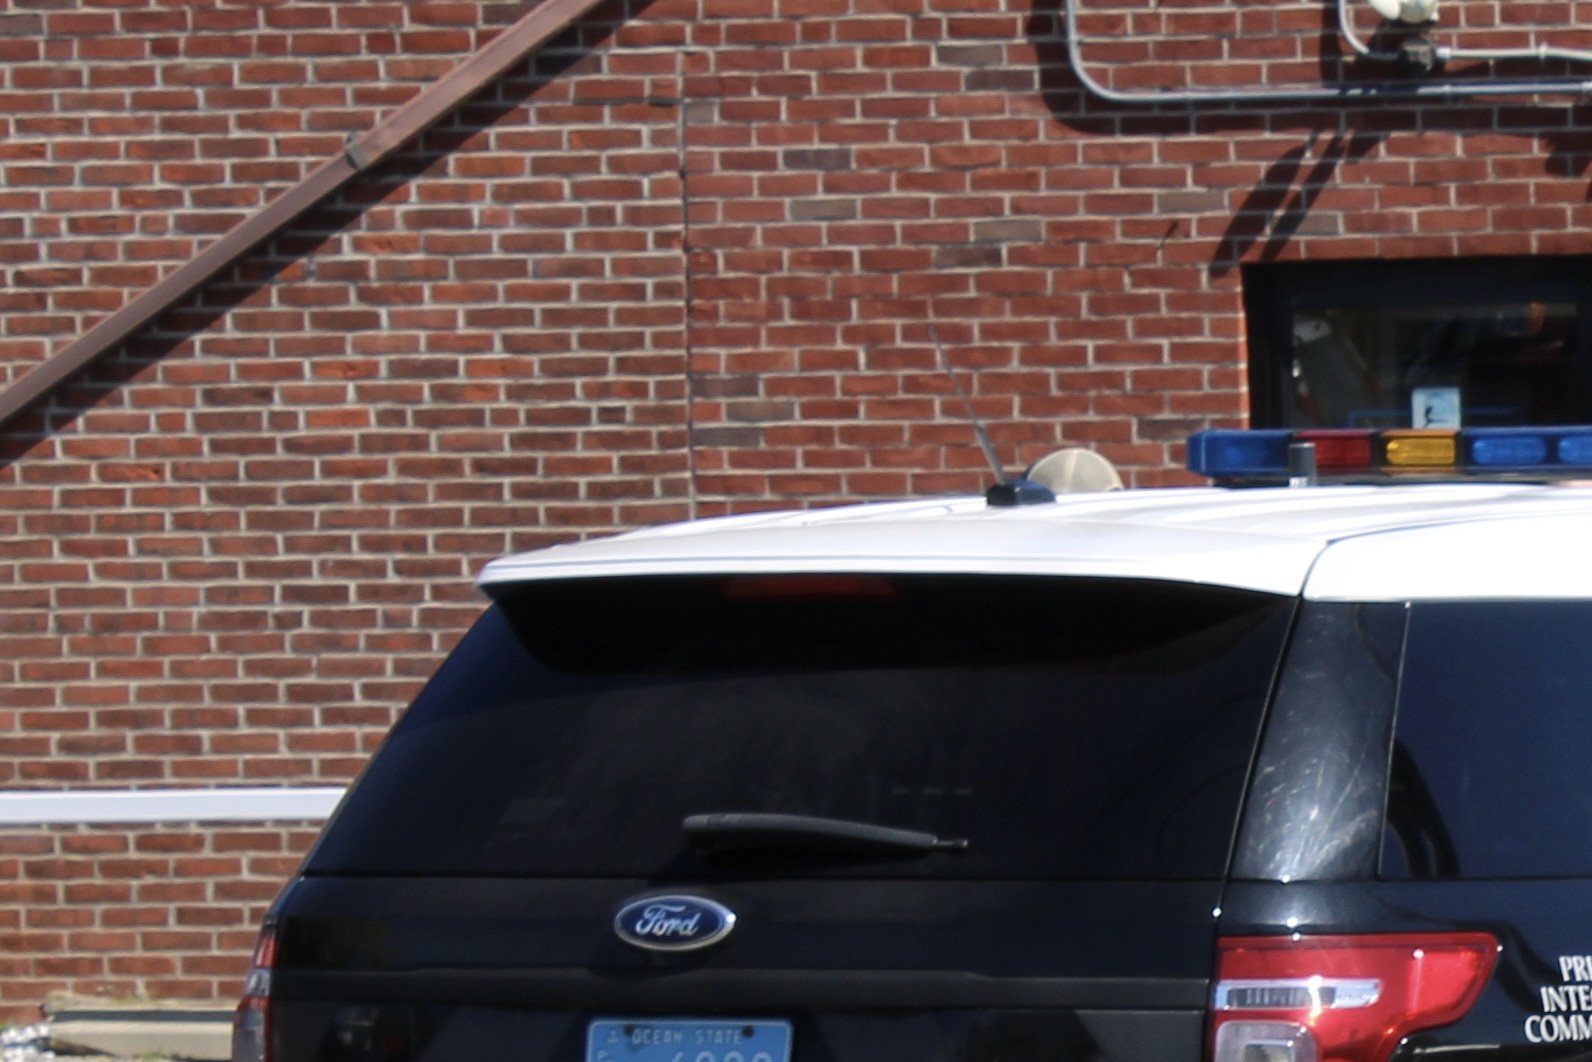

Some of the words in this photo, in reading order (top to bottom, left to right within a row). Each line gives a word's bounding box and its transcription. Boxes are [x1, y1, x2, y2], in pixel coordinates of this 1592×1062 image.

[635, 904, 702, 936] Ford
[632, 1029, 683, 1045] OCEAN
[695, 1029, 743, 1044] STATE
